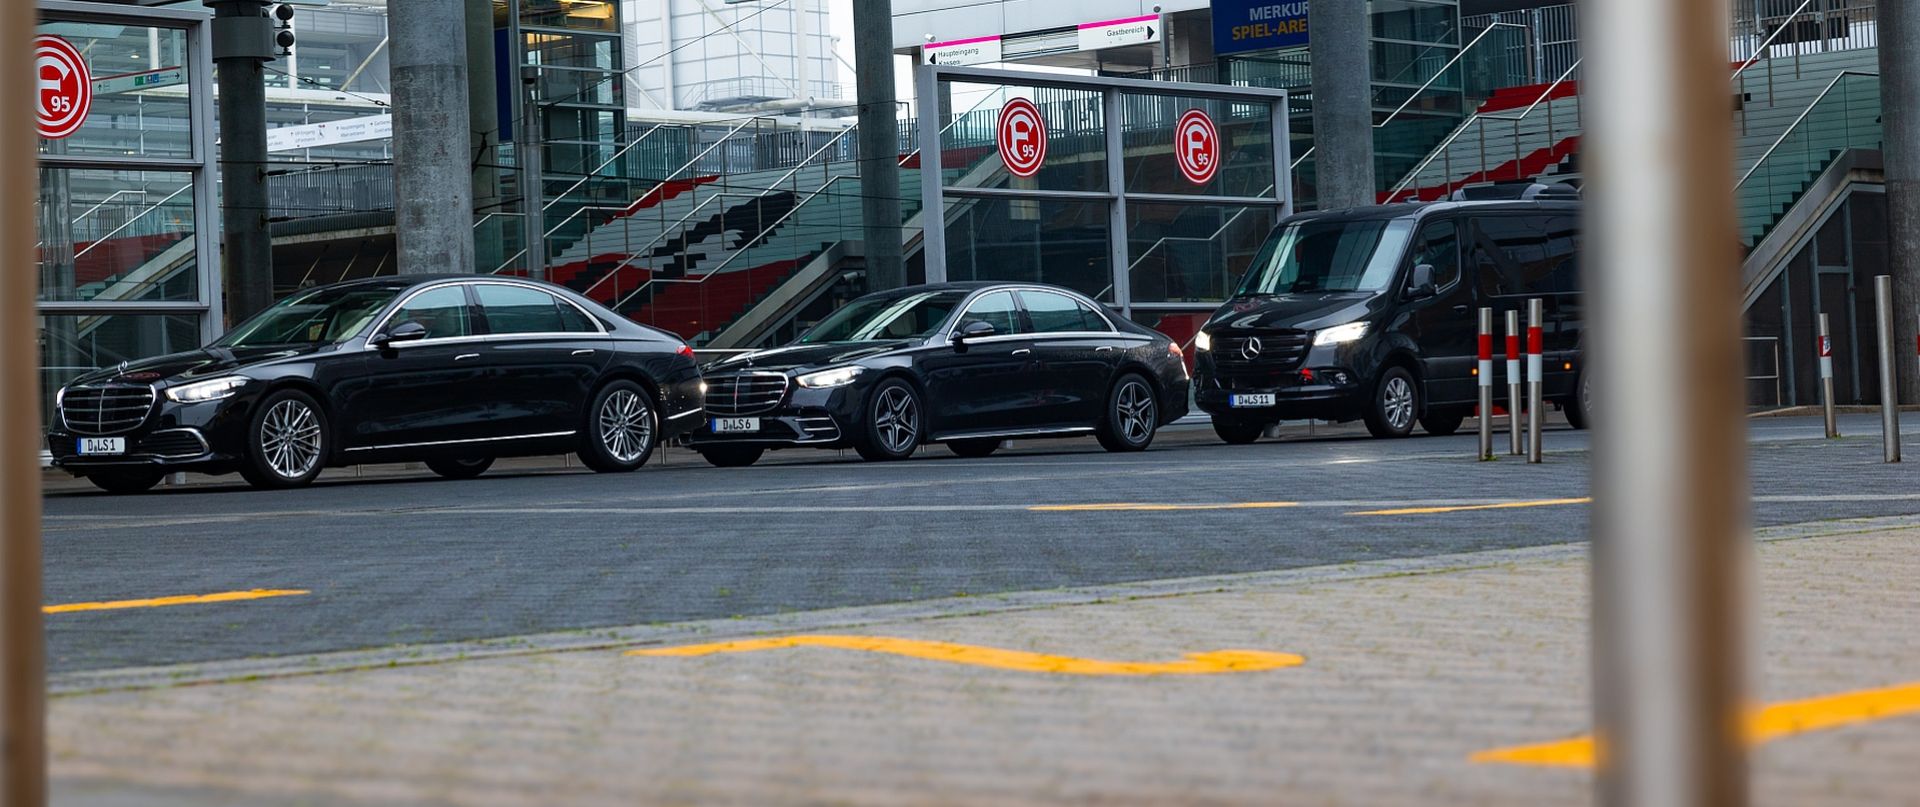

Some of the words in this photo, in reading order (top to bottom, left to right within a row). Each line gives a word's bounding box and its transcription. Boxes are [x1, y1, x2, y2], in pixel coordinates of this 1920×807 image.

[1249, 1, 1309, 21] MERKUR
[1106, 26, 1145, 37] Gastbereich
[938, 48, 979, 58] Haupteingang
[51, 95, 71, 113] 95
[1022, 144, 1035, 158] 95
[1197, 152, 1209, 165] 95
